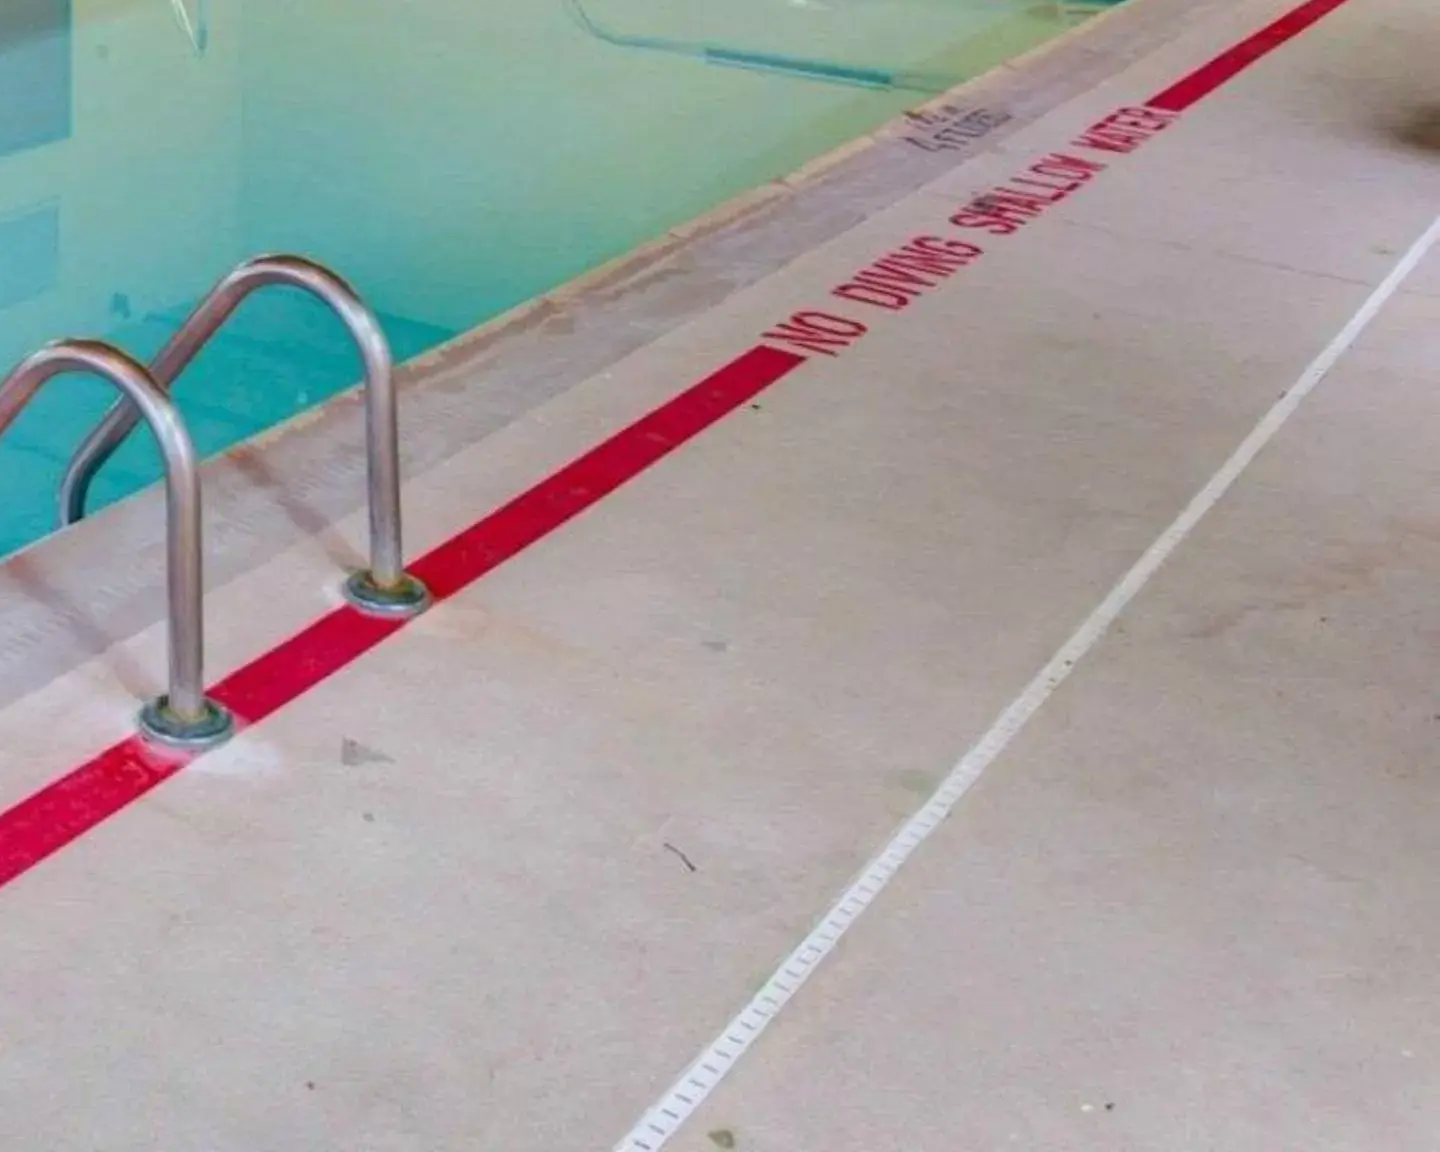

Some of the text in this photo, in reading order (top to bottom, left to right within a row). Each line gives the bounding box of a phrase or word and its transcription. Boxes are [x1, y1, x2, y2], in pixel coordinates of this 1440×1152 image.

[761, 310, 868, 358] NO
[830, 234, 984, 310] DIVING
[1069, 106, 1181, 154] WATER
